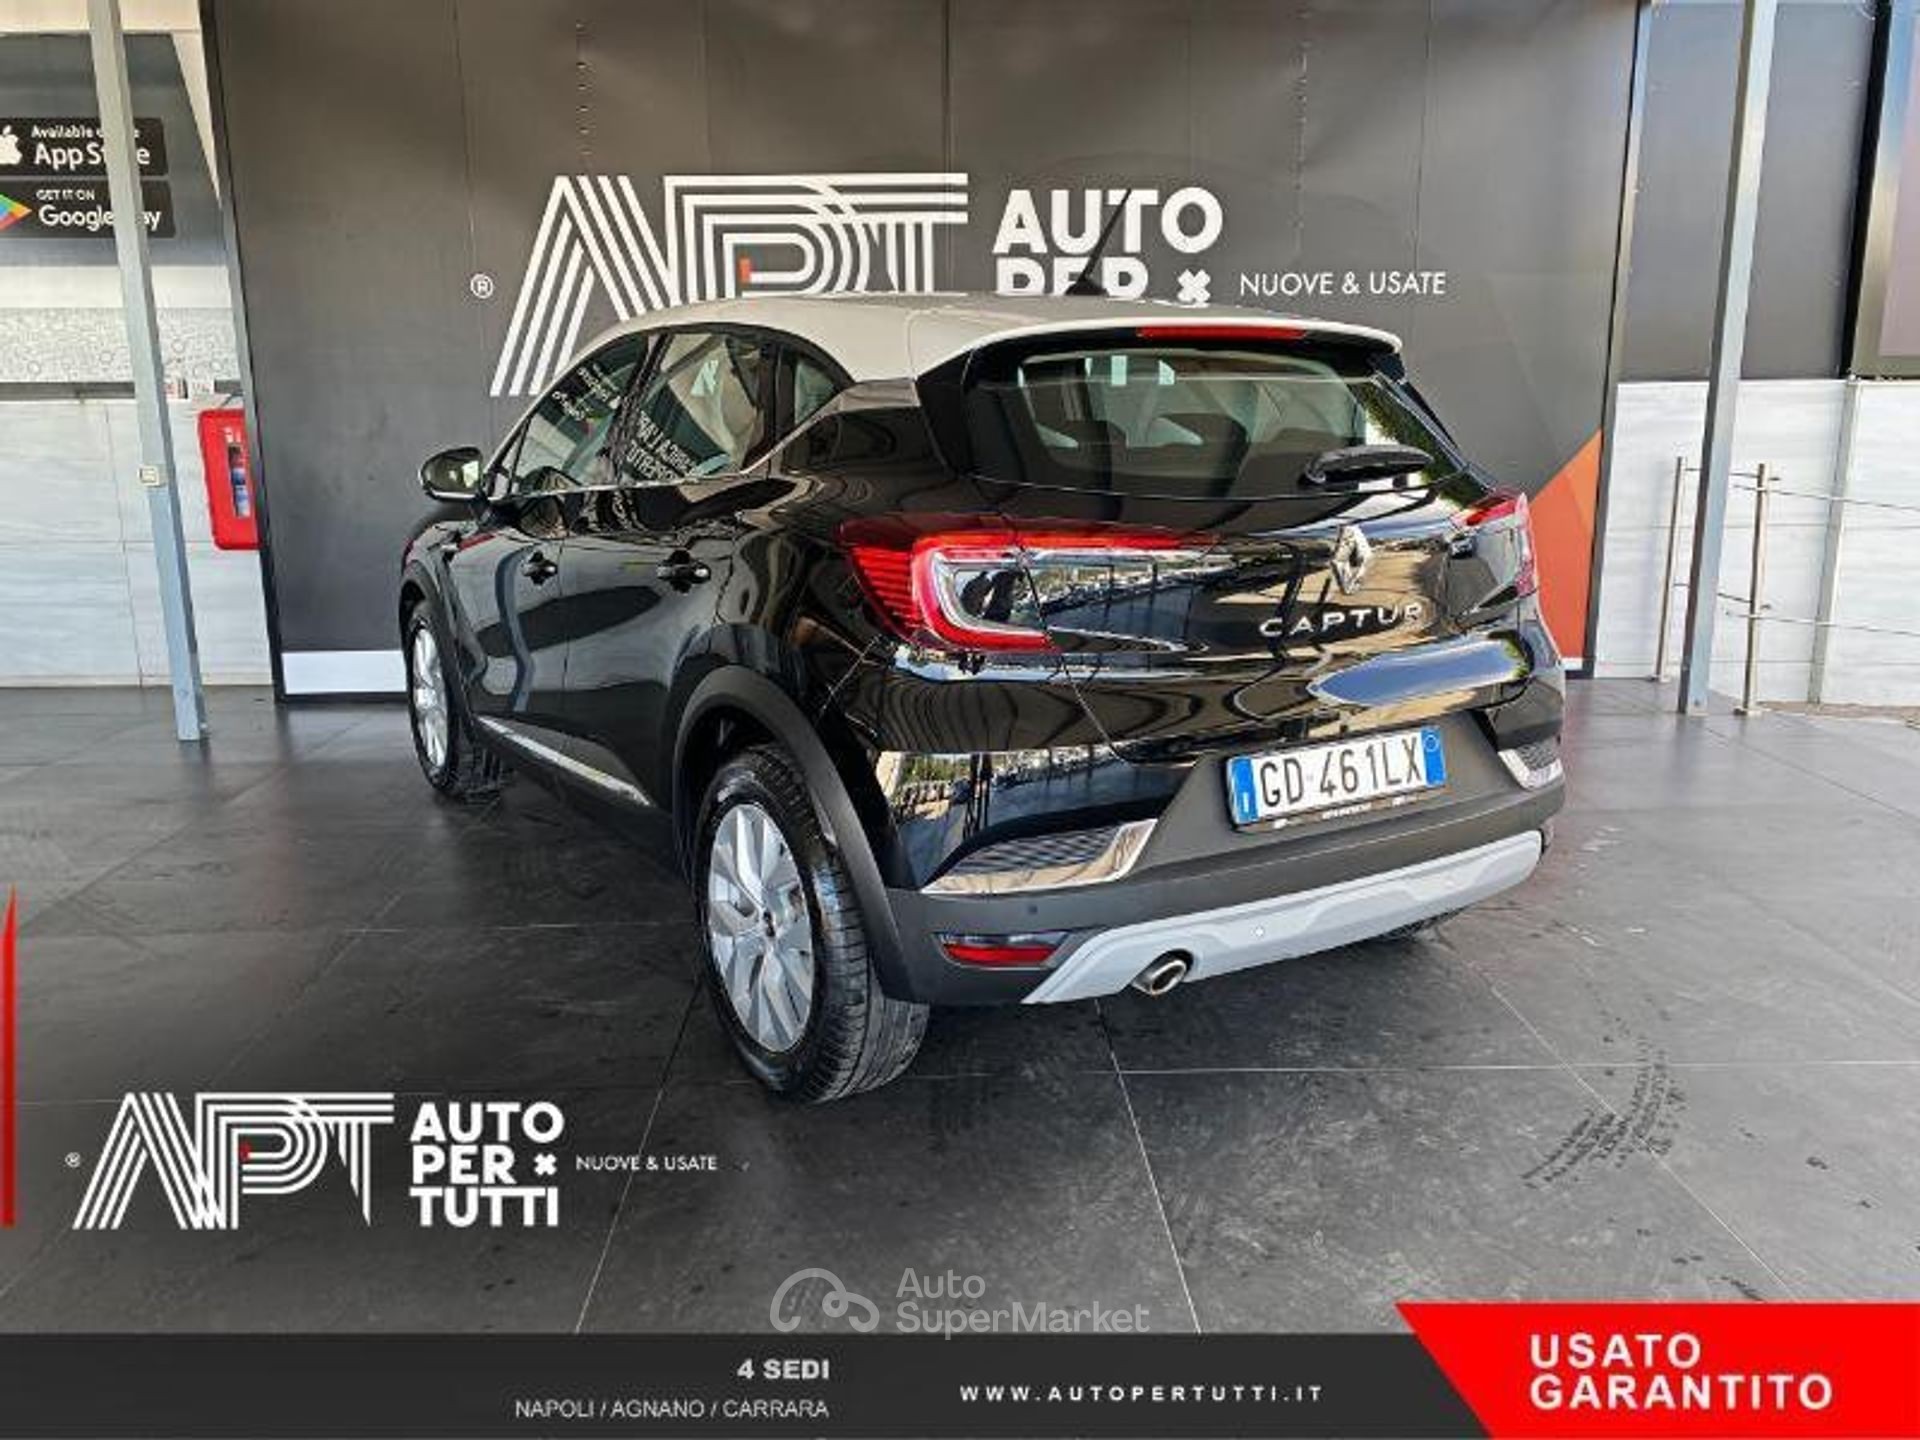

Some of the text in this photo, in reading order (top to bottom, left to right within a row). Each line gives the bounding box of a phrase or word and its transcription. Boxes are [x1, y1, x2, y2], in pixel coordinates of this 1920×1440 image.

[31, 124, 93, 138] Available
[34, 141, 83, 170] App
[36, 189, 60, 200] GET
[75, 189, 95, 200] ON
[39, 204, 114, 231] Google
[992, 187, 1224, 254] AUTO
[1240, 271, 1447, 296] NUOVE & USATE
[1259, 602, 1423, 636] CAPTUR
[1260, 737, 1423, 808] GD 461LX
